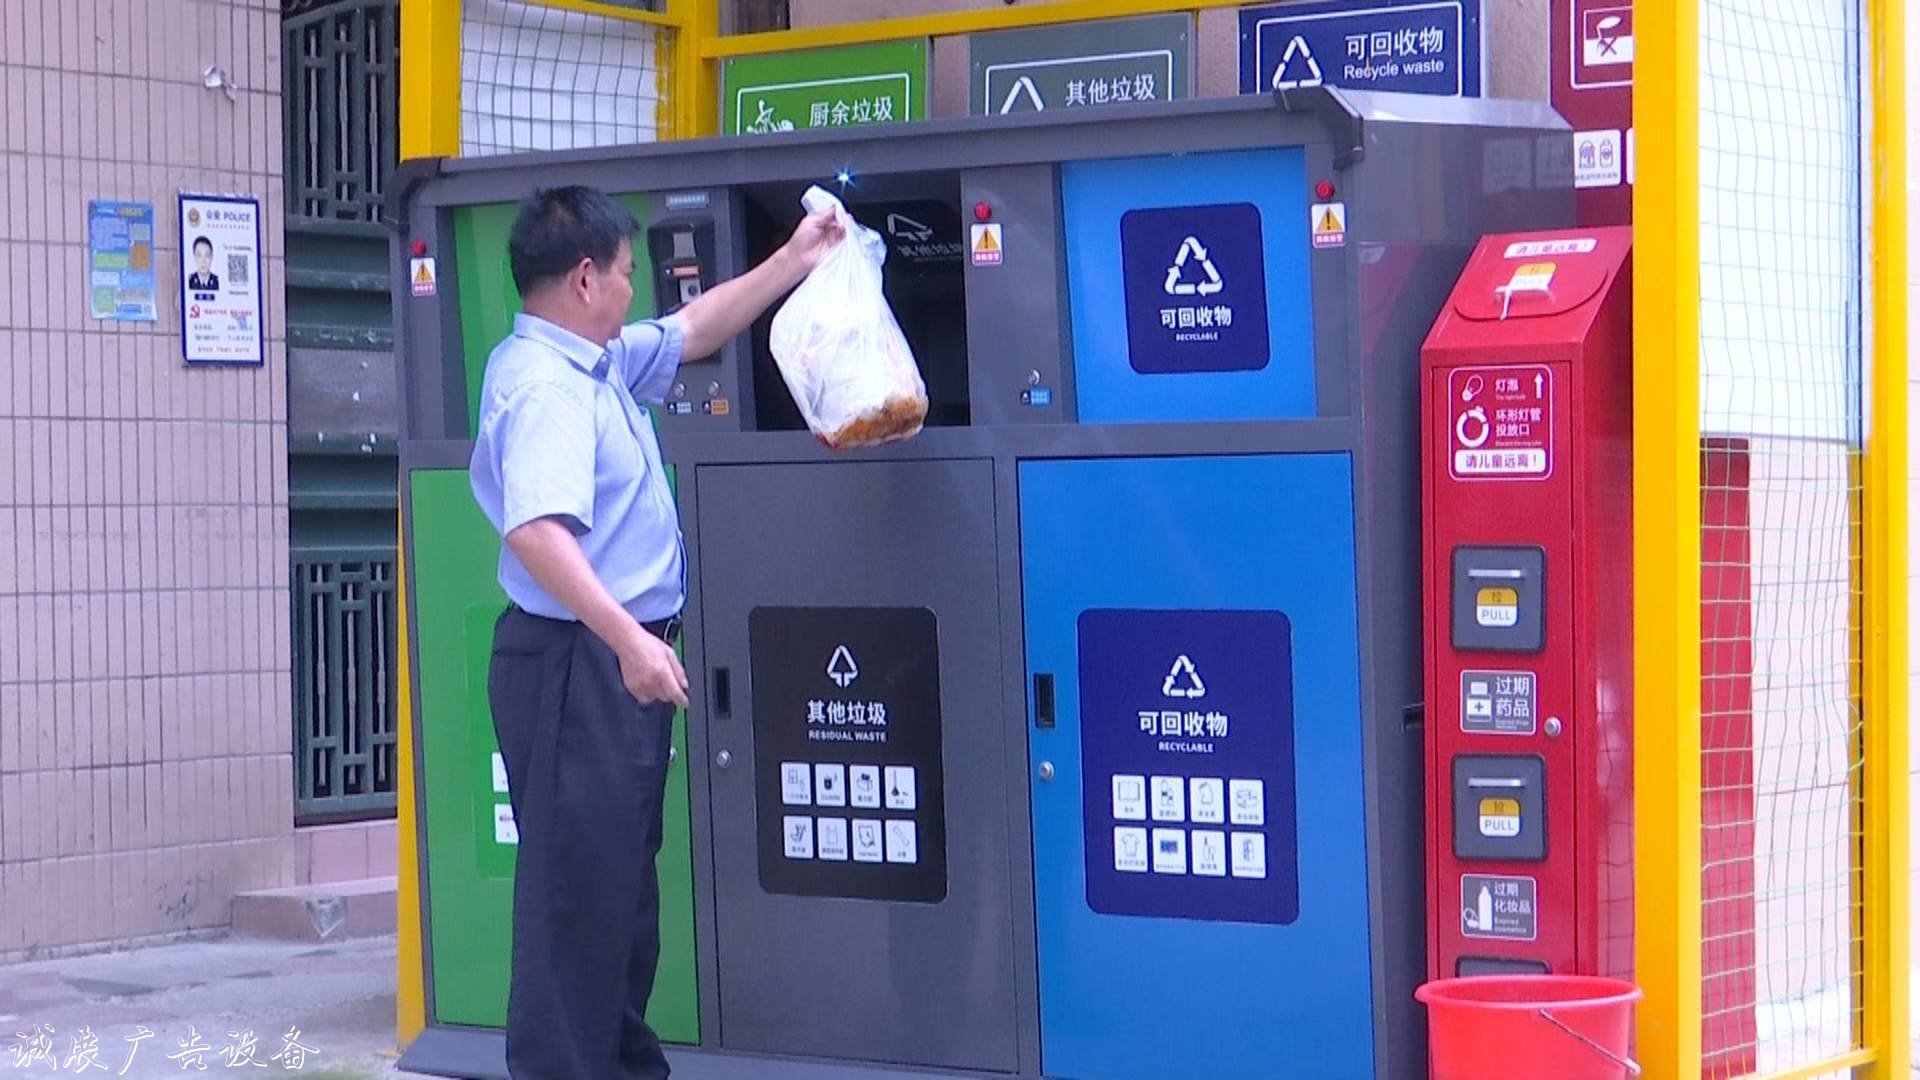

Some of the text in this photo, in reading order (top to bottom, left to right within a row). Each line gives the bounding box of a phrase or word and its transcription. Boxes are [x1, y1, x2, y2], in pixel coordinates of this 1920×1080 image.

[1345, 26, 1443, 60] 可回收物
[1344, 59, 1444, 80] Recycle waste
[1065, 74, 1156, 107] 其他垃圾
[809, 96, 893, 127] 厨余垃圾
[223, 211, 251, 222] POLICE
[1160, 305, 1232, 329] 可回收物
[1175, 331, 1219, 341] RECYCLABLE
[1495, 377, 1519, 392] 灯泡
[1495, 407, 1542, 422] 环形灯管
[1495, 423, 1530, 437] 投放口
[1482, 608, 1512, 621] PULL
[1496, 675, 1530, 696] 过期
[807, 699, 887, 725] 其他垃圾
[1496, 697, 1530, 717] 药品
[1138, 711, 1228, 737] 可回收物
[808, 730, 887, 742] RESIDUAL WASTE
[1158, 741, 1214, 753] RECYCLABLE
[1484, 818, 1515, 831] PULL
[1494, 880, 1519, 896] 过期
[1494, 899, 1531, 913] 化妆品
